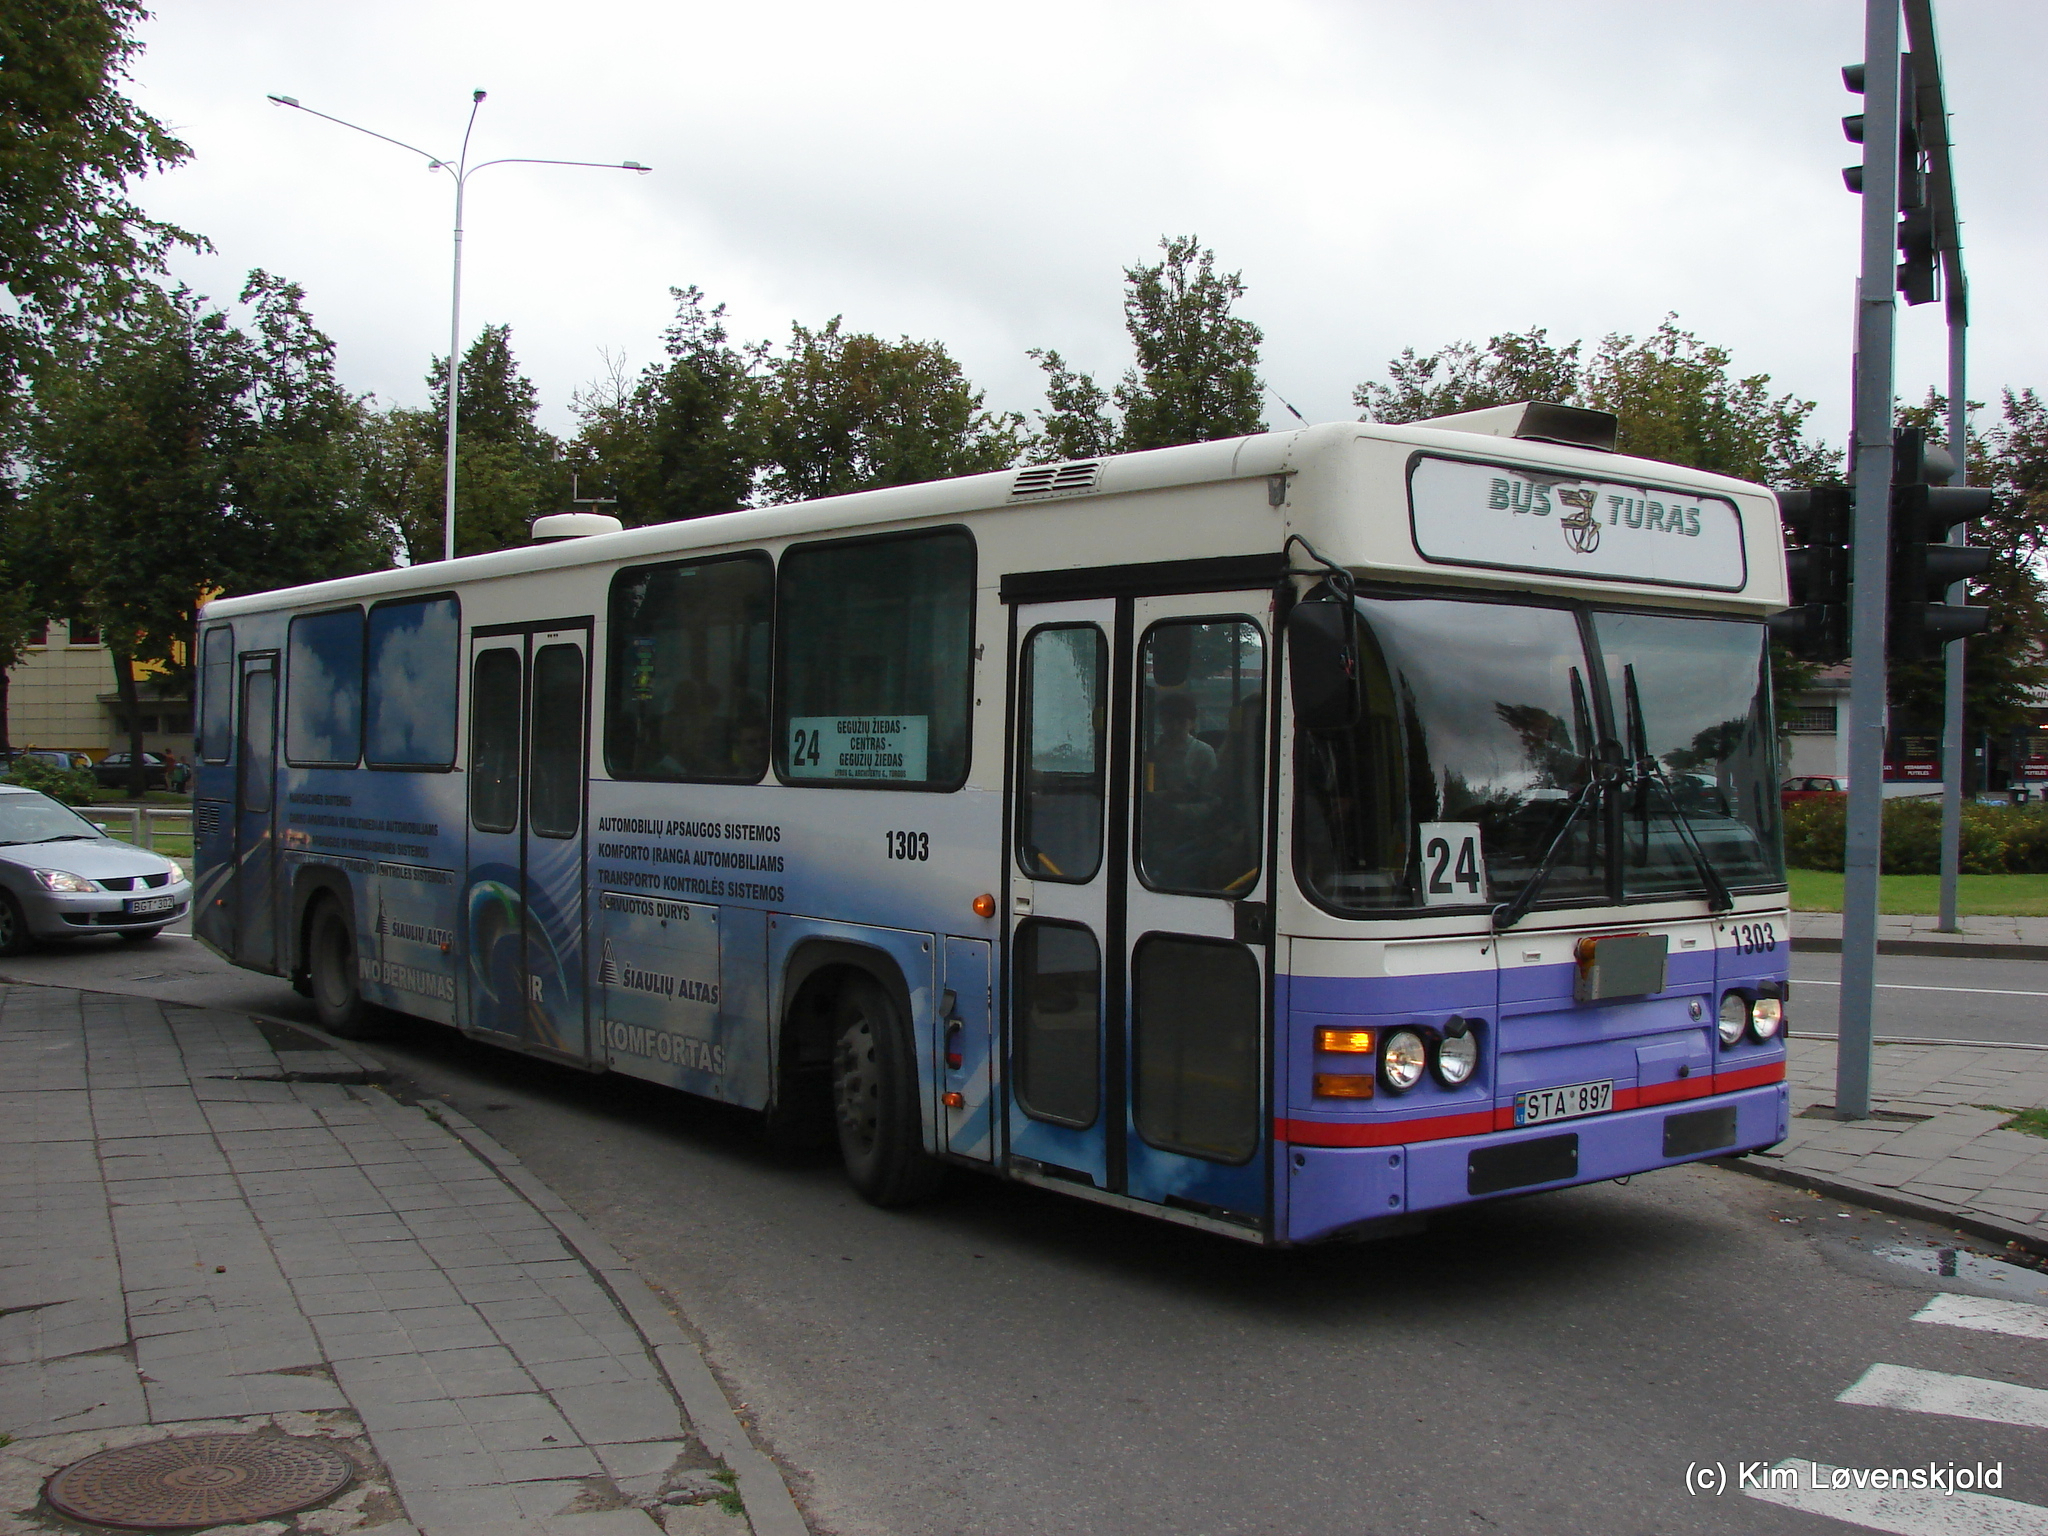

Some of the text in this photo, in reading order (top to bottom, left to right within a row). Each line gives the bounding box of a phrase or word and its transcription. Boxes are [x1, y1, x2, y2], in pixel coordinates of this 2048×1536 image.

[1488, 477, 1700, 537] BUS TURAS
[872, 718, 900, 734] ŽIEDAS
[794, 729, 820, 766] 24
[850, 737, 886, 750] CENTRAS
[874, 751, 903, 767] ŽIEDAS
[599, 816, 781, 843] AUTOMOBILIŲ APSAUGOS SISTEMOS
[598, 843, 784, 872] KOMFORTO ĮRANGA AUTOMOBILIAMS
[886, 830, 929, 862] 1303
[1427, 837, 1480, 894] 24
[598, 869, 784, 902] TRANSPORTO KONTROLĖS SISTEMOS
[134, 898, 173, 912] BGT 302
[657, 902, 690, 921] DURYS
[1730, 922, 1775, 956] 1303
[623, 962, 719, 1005] ŠIAULIŲ ALTAS
[599, 1019, 727, 1075] KOMFORTAS
[1527, 1084, 1610, 1119] STA 897
